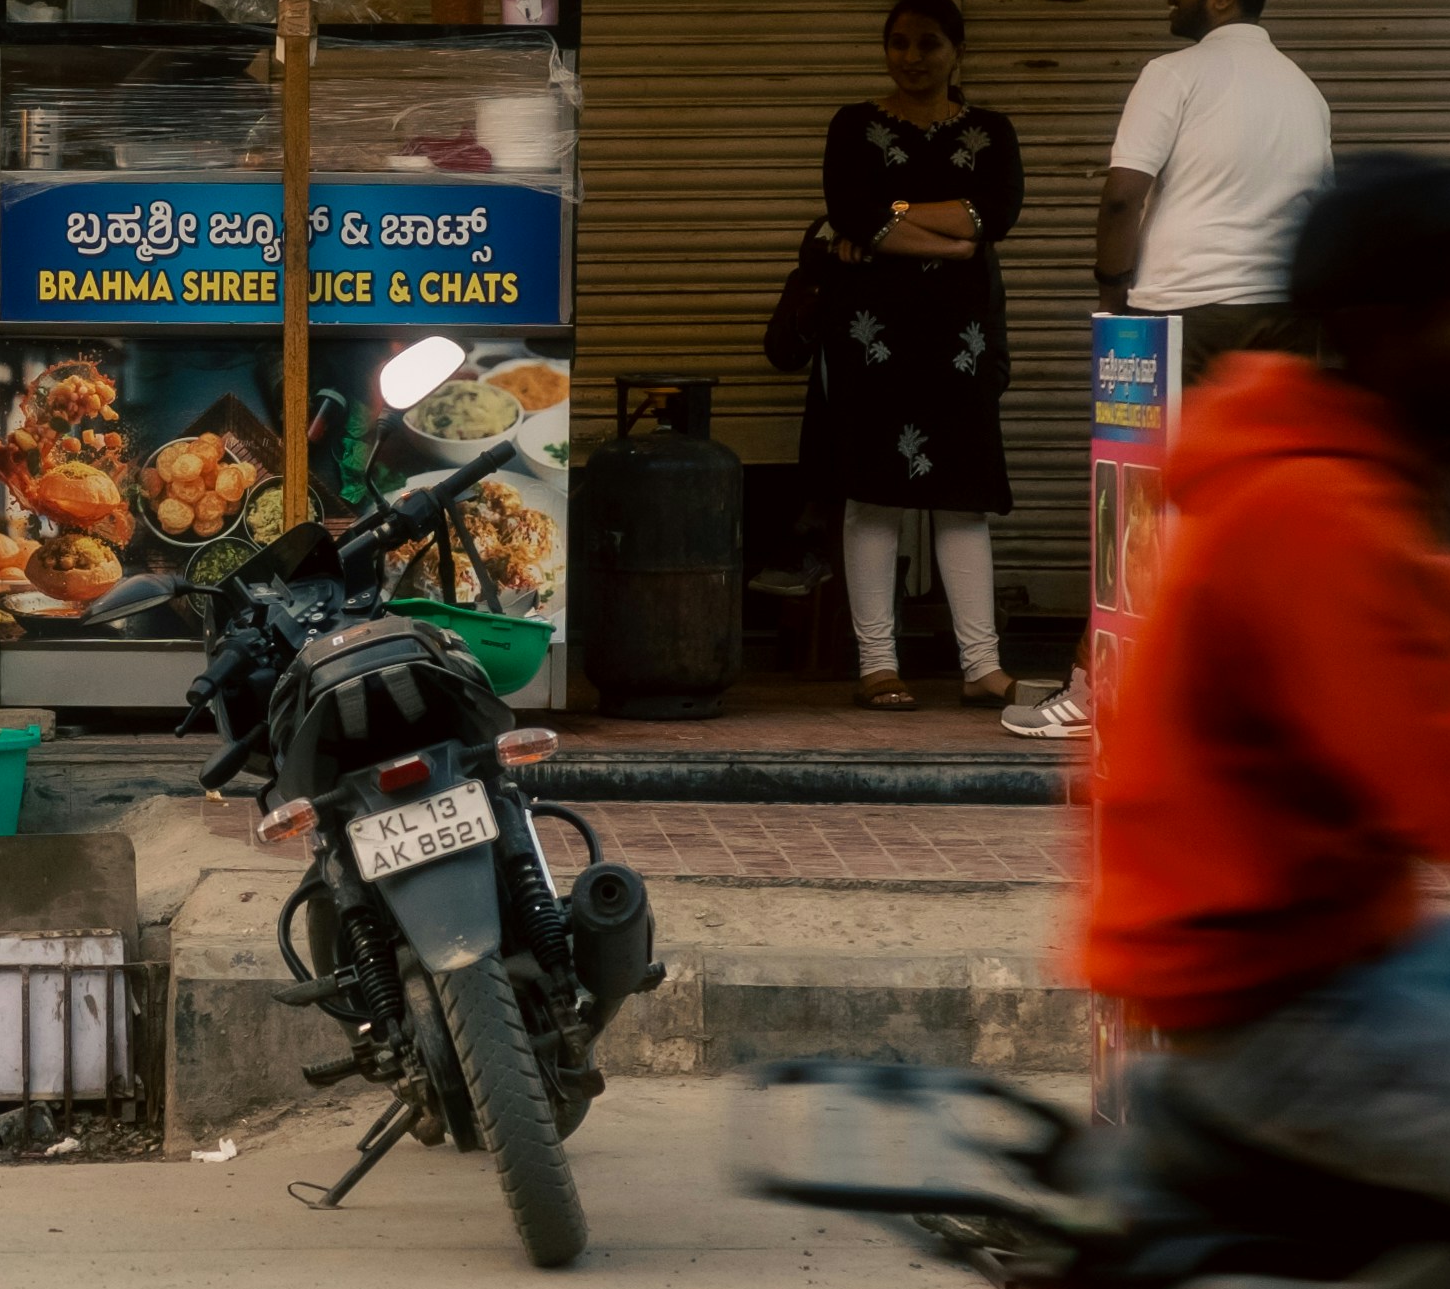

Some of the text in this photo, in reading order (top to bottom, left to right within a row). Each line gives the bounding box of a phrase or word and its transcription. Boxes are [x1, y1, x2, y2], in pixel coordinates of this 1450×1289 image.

[67, 200, 197, 261] ಬ್ರಹ್ಮಶ್ರೀ
[341, 212, 370, 245] &
[39, 270, 518, 304] BRAHMA SHREE UICE & CHATS
[378, 797, 457, 840] KL 13
[373, 817, 487, 874] AK 8521
